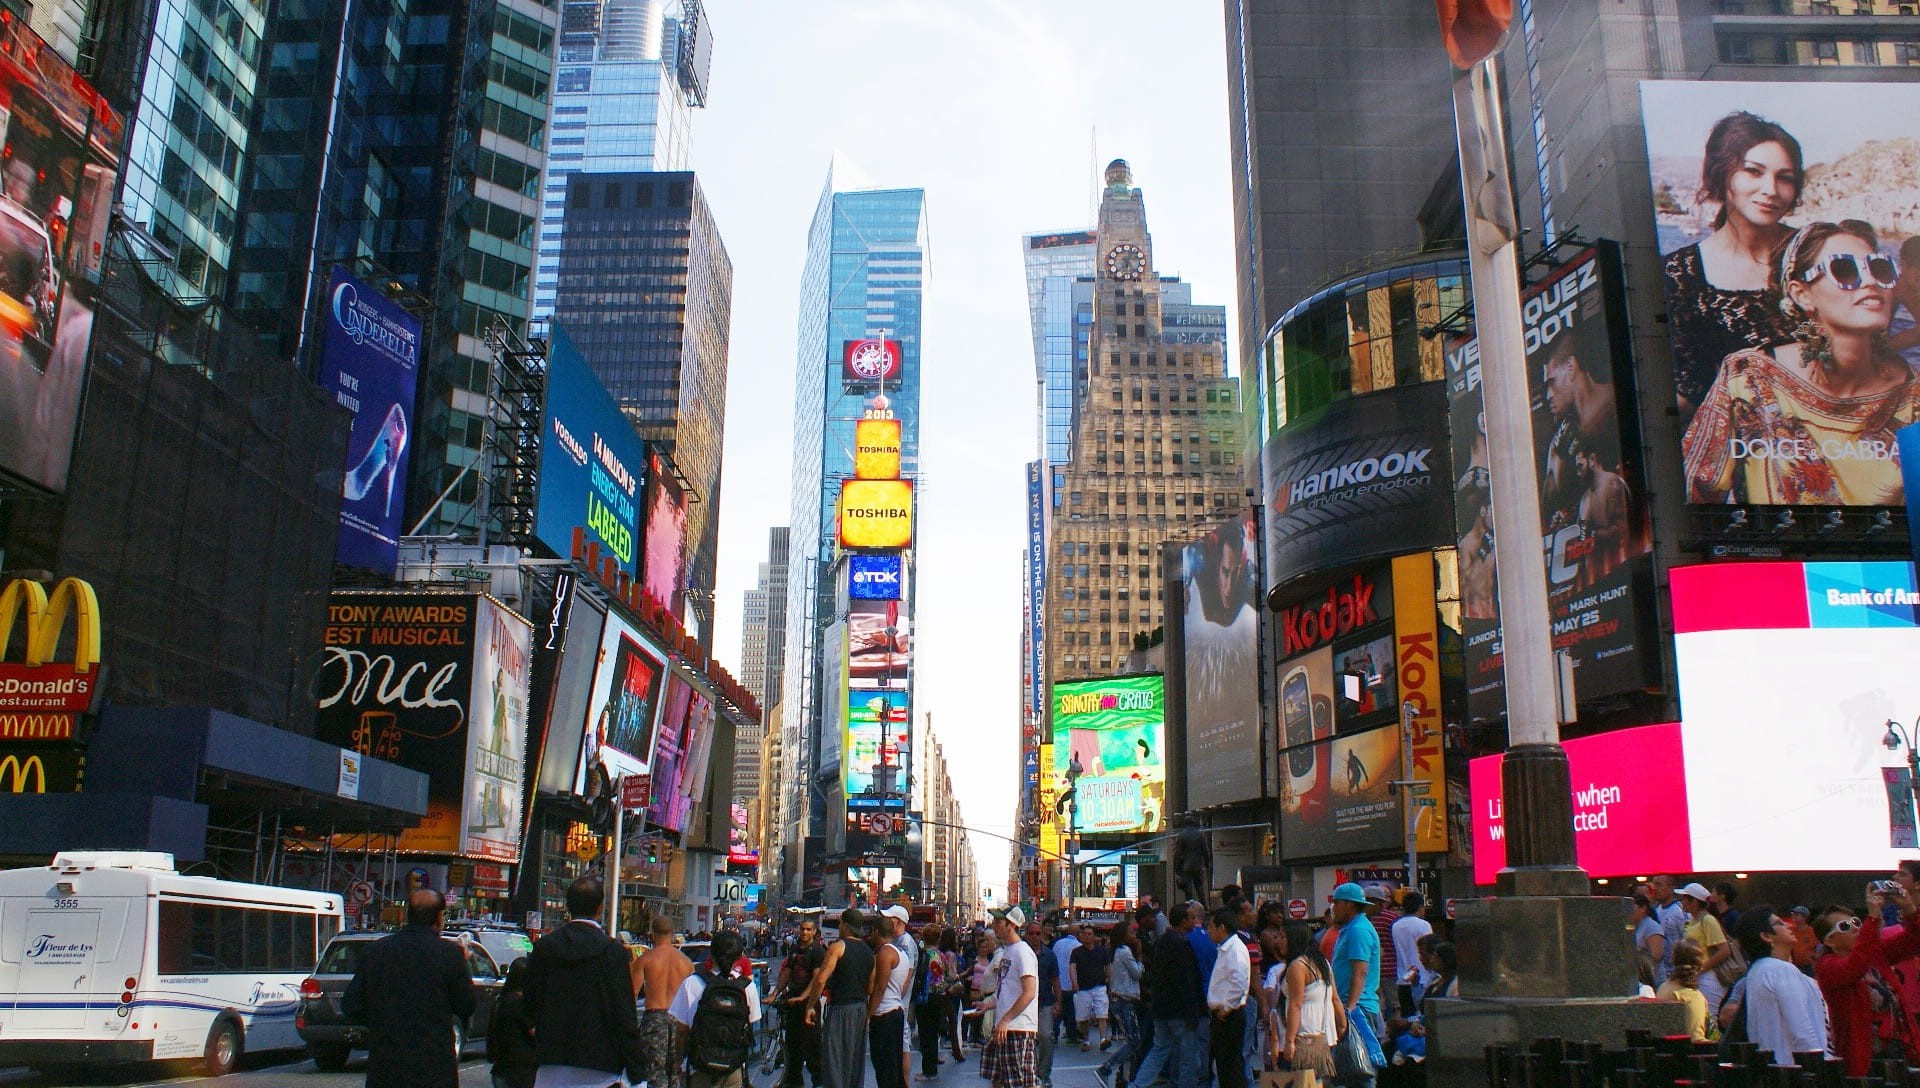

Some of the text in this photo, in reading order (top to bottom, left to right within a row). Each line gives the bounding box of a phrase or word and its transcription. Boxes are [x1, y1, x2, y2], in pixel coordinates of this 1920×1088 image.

[333, 282, 416, 366] CINDERELLA
[337, 390, 360, 413] INVITED
[865, 409, 894, 420] 2013
[553, 417, 588, 465] VORNADO
[858, 446, 898, 454] TOSHIBA
[1730, 438, 1901, 461] DOLCE & GABBA
[592, 432, 636, 499] 14 MILLION SF
[591, 461, 634, 527] ENERGY STAR
[1307, 474, 1431, 509] driving emotion
[847, 508, 907, 518] TOSHIBA
[587, 490, 632, 564] LABELED
[1033, 532, 1041, 543] IS
[1034, 545, 1041, 562] ON
[864, 571, 898, 583] TDK
[1034, 563, 1042, 587] THE
[1570, 594, 1599, 613] MARK
[1599, 584, 1628, 604] HUNT
[1826, 587, 1873, 606] Bank
[1874, 587, 1893, 605] of
[327, 605, 467, 623] TONY AWARDS
[1035, 589, 1043, 628] CLOCK
[1283, 574, 1377, 656] Kodak
[1554, 609, 1600, 636] MAY 25
[325, 628, 465, 645] EST MUSICAL
[1468, 629, 1496, 646] JUNIOR
[1036, 641, 1044, 680] SUPER
[0, 678, 88, 694] cDonald's
[0, 697, 67, 707] estaurant
[1061, 692, 1103, 714] SANJAY
[1118, 689, 1154, 711] CRAIG
[1400, 631, 1440, 773] Kodak
[1080, 780, 1135, 800] SATURDAYS
[1577, 783, 1621, 808] when
[1094, 818, 1136, 828] nickelodeon
[1357, 870, 1437, 879] MARQIS
[54, 899, 79, 909] 3555
[80, 943, 94, 953] Lys
